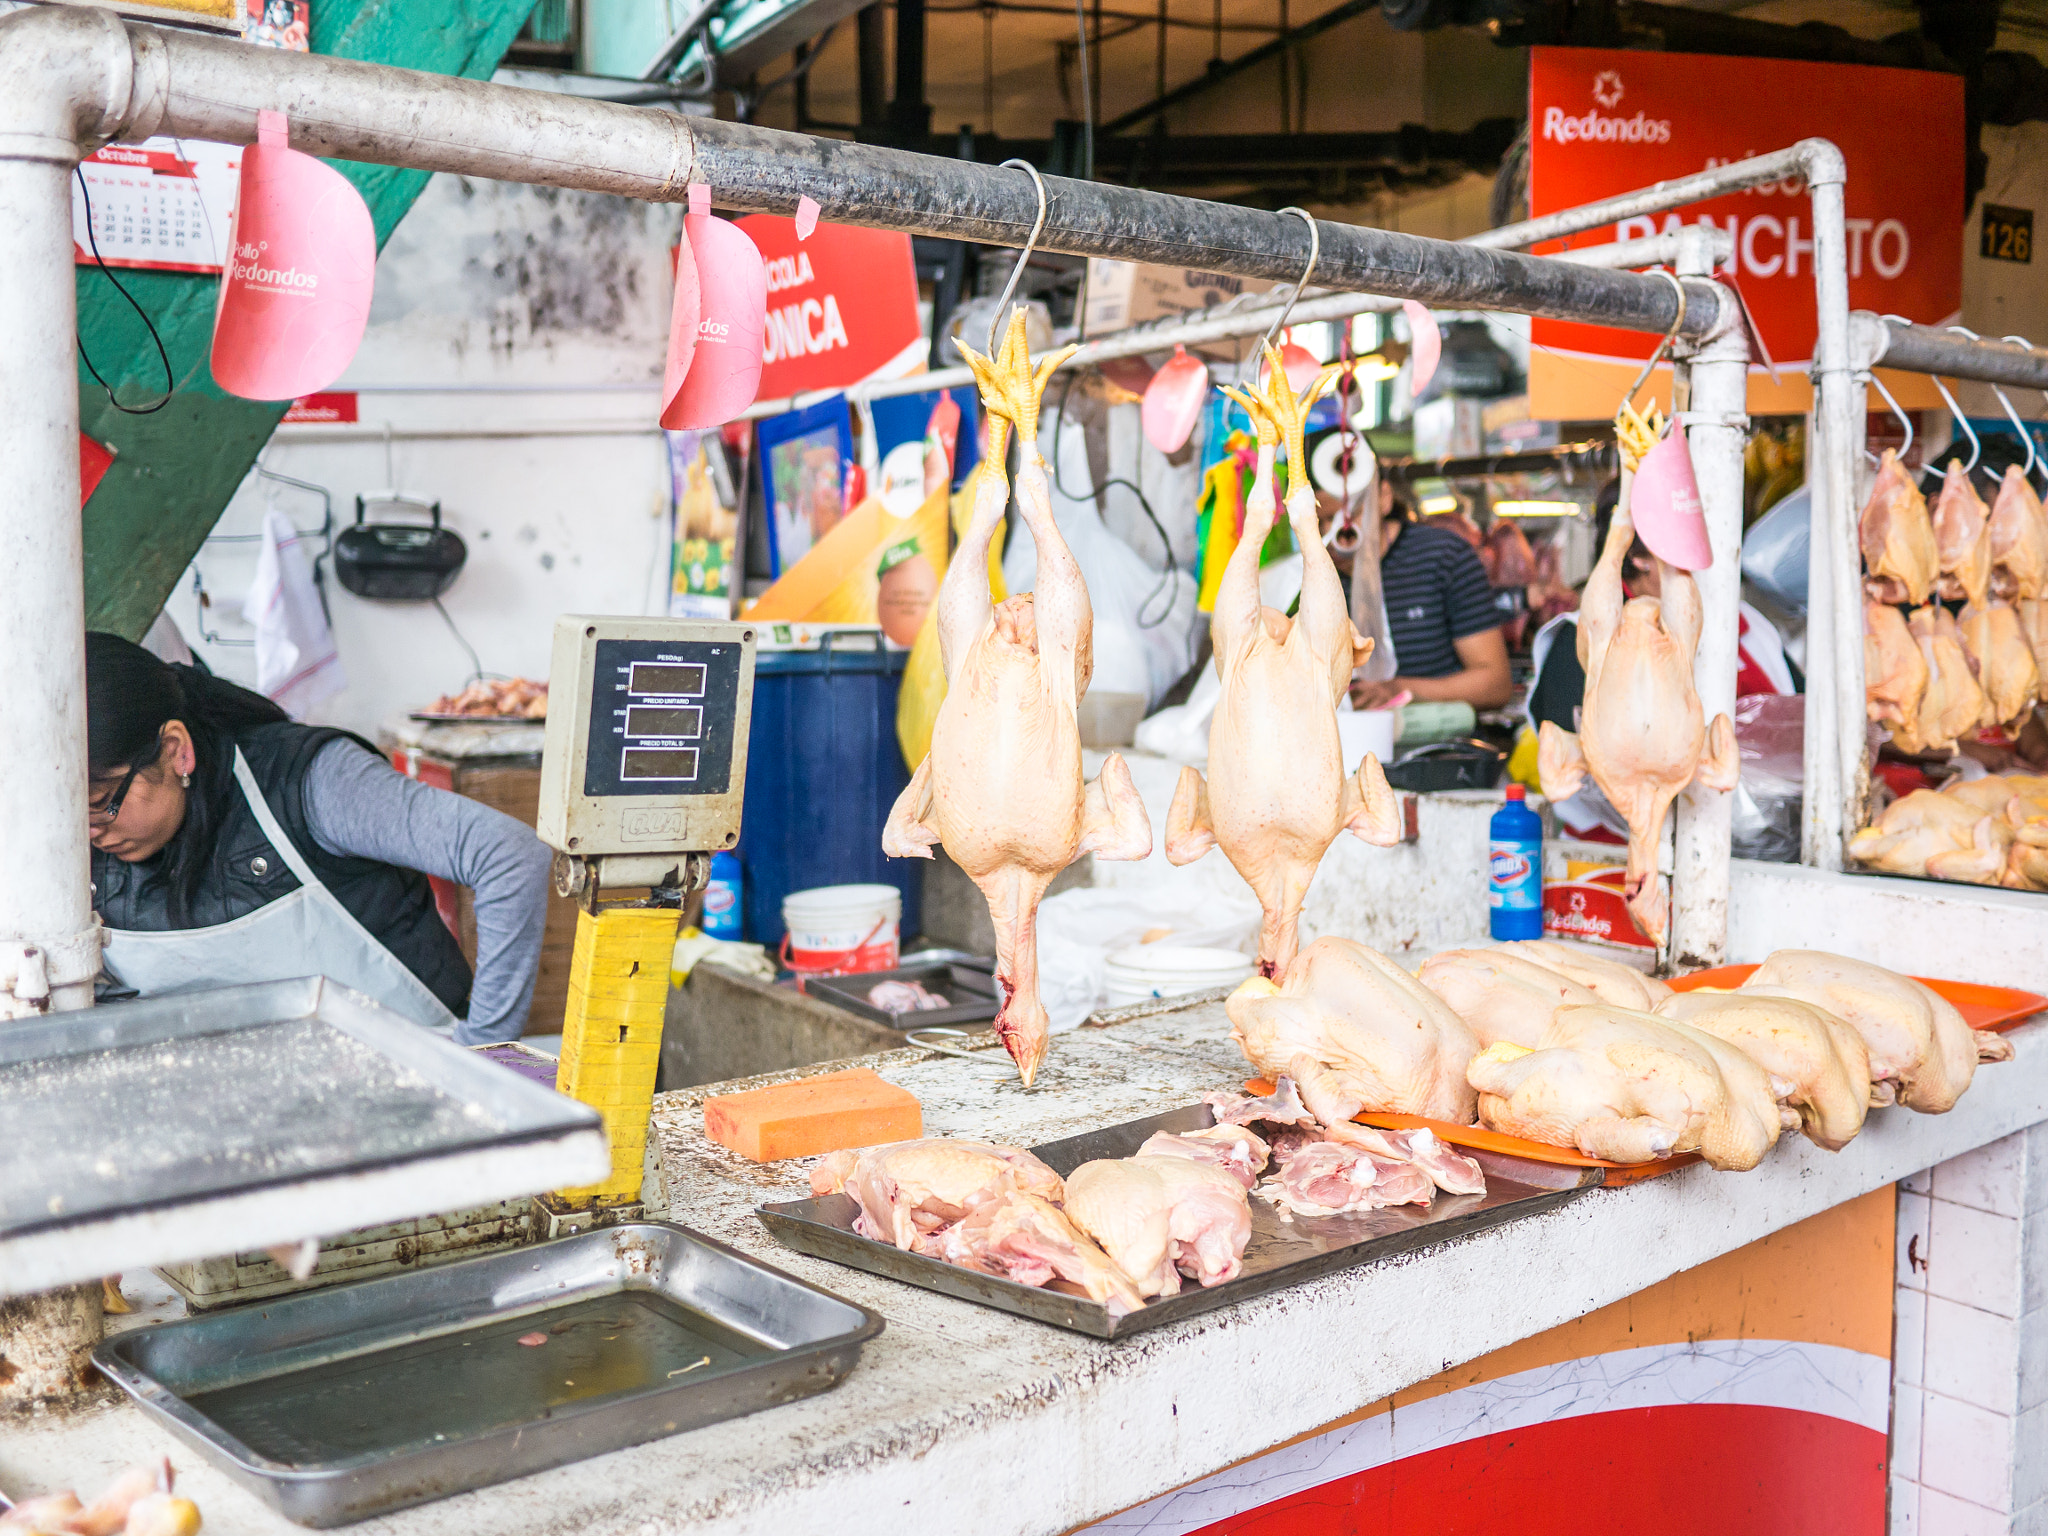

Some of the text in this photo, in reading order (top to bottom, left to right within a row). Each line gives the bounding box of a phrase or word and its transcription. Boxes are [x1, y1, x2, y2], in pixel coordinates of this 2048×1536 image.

[1543, 106, 1671, 144] Redondos
[97, 150, 149, 165] Octubre
[1616, 213, 1909, 279] NCHTO
[1984, 222, 2029, 260] 126
[233, 258, 318, 288] Redondos
[711, 648, 721, 656] AC
[664, 698, 690, 706] UNITARIO
